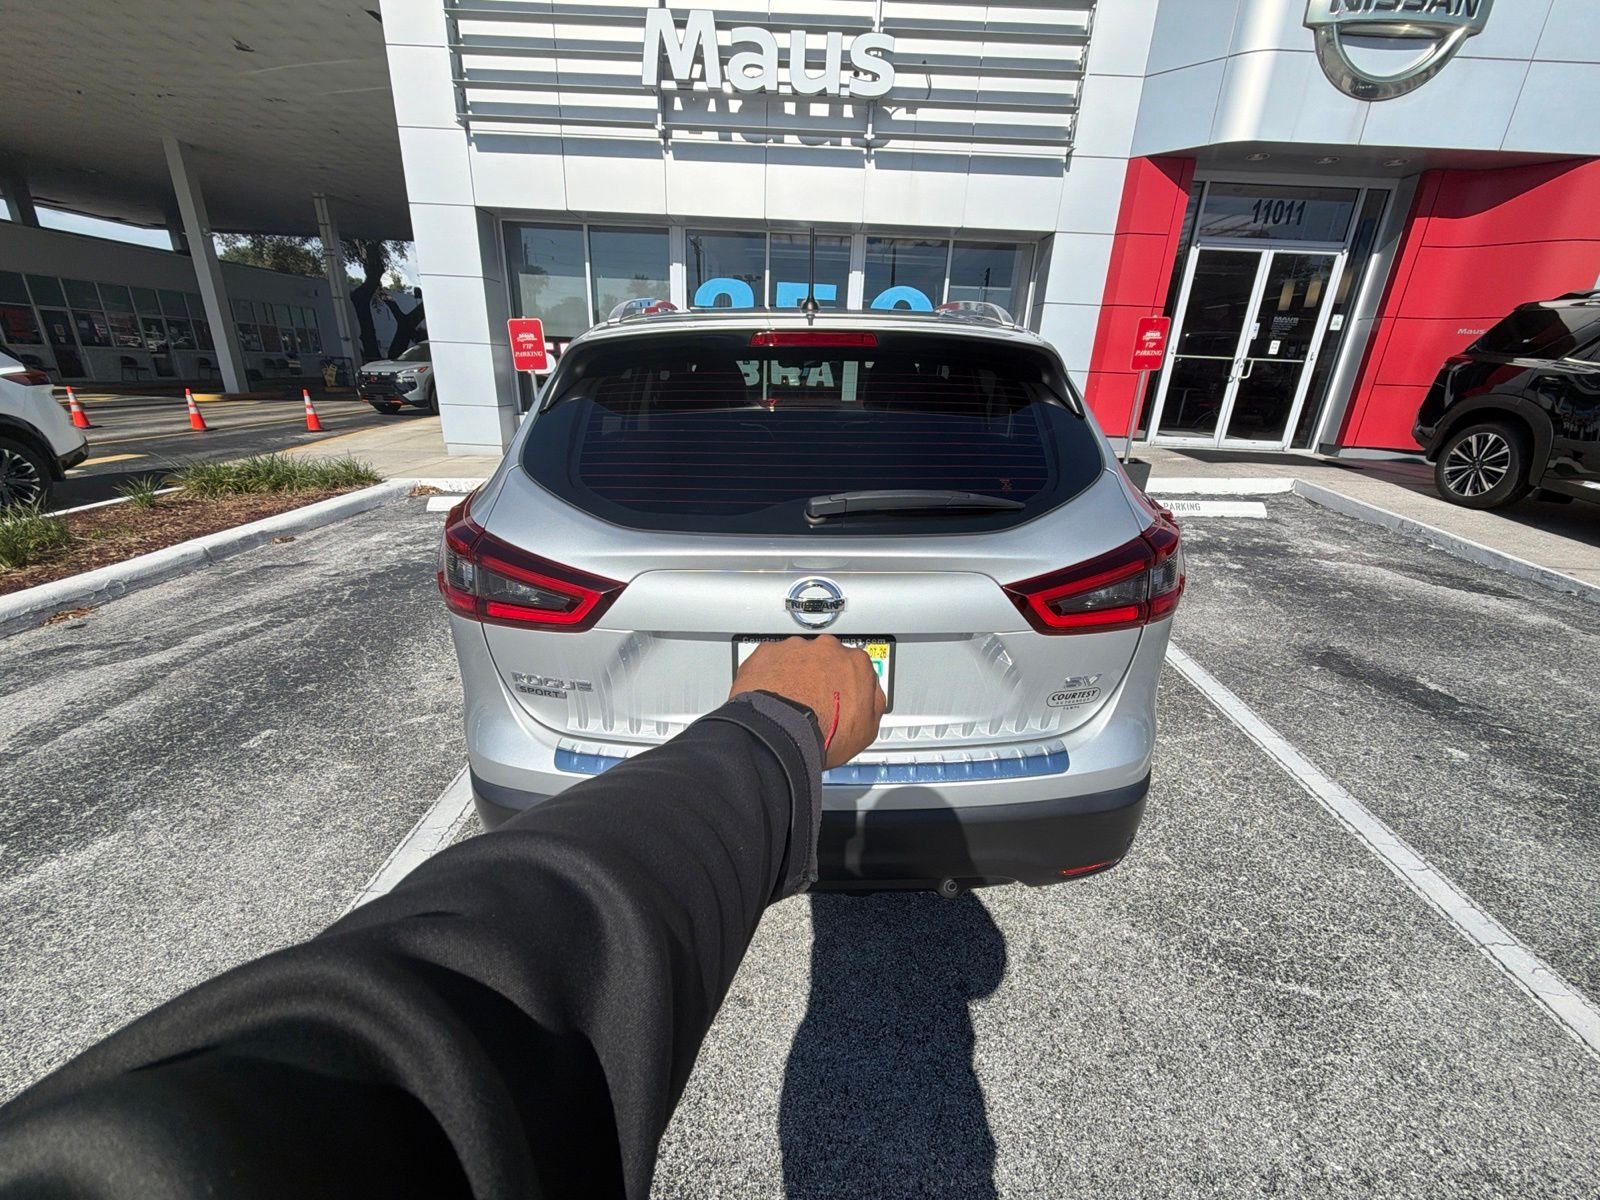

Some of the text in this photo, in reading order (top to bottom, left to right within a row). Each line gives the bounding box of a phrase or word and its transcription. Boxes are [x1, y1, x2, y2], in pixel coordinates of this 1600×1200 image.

[641, 8, 896, 98] Maus
[1252, 199, 1307, 226] 11011
[1163, 502, 1201, 511] PARKING
[791, 600, 840, 610] NISSAN
[519, 685, 562, 699] SPORT
[1052, 689, 1098, 701] COURTESY
